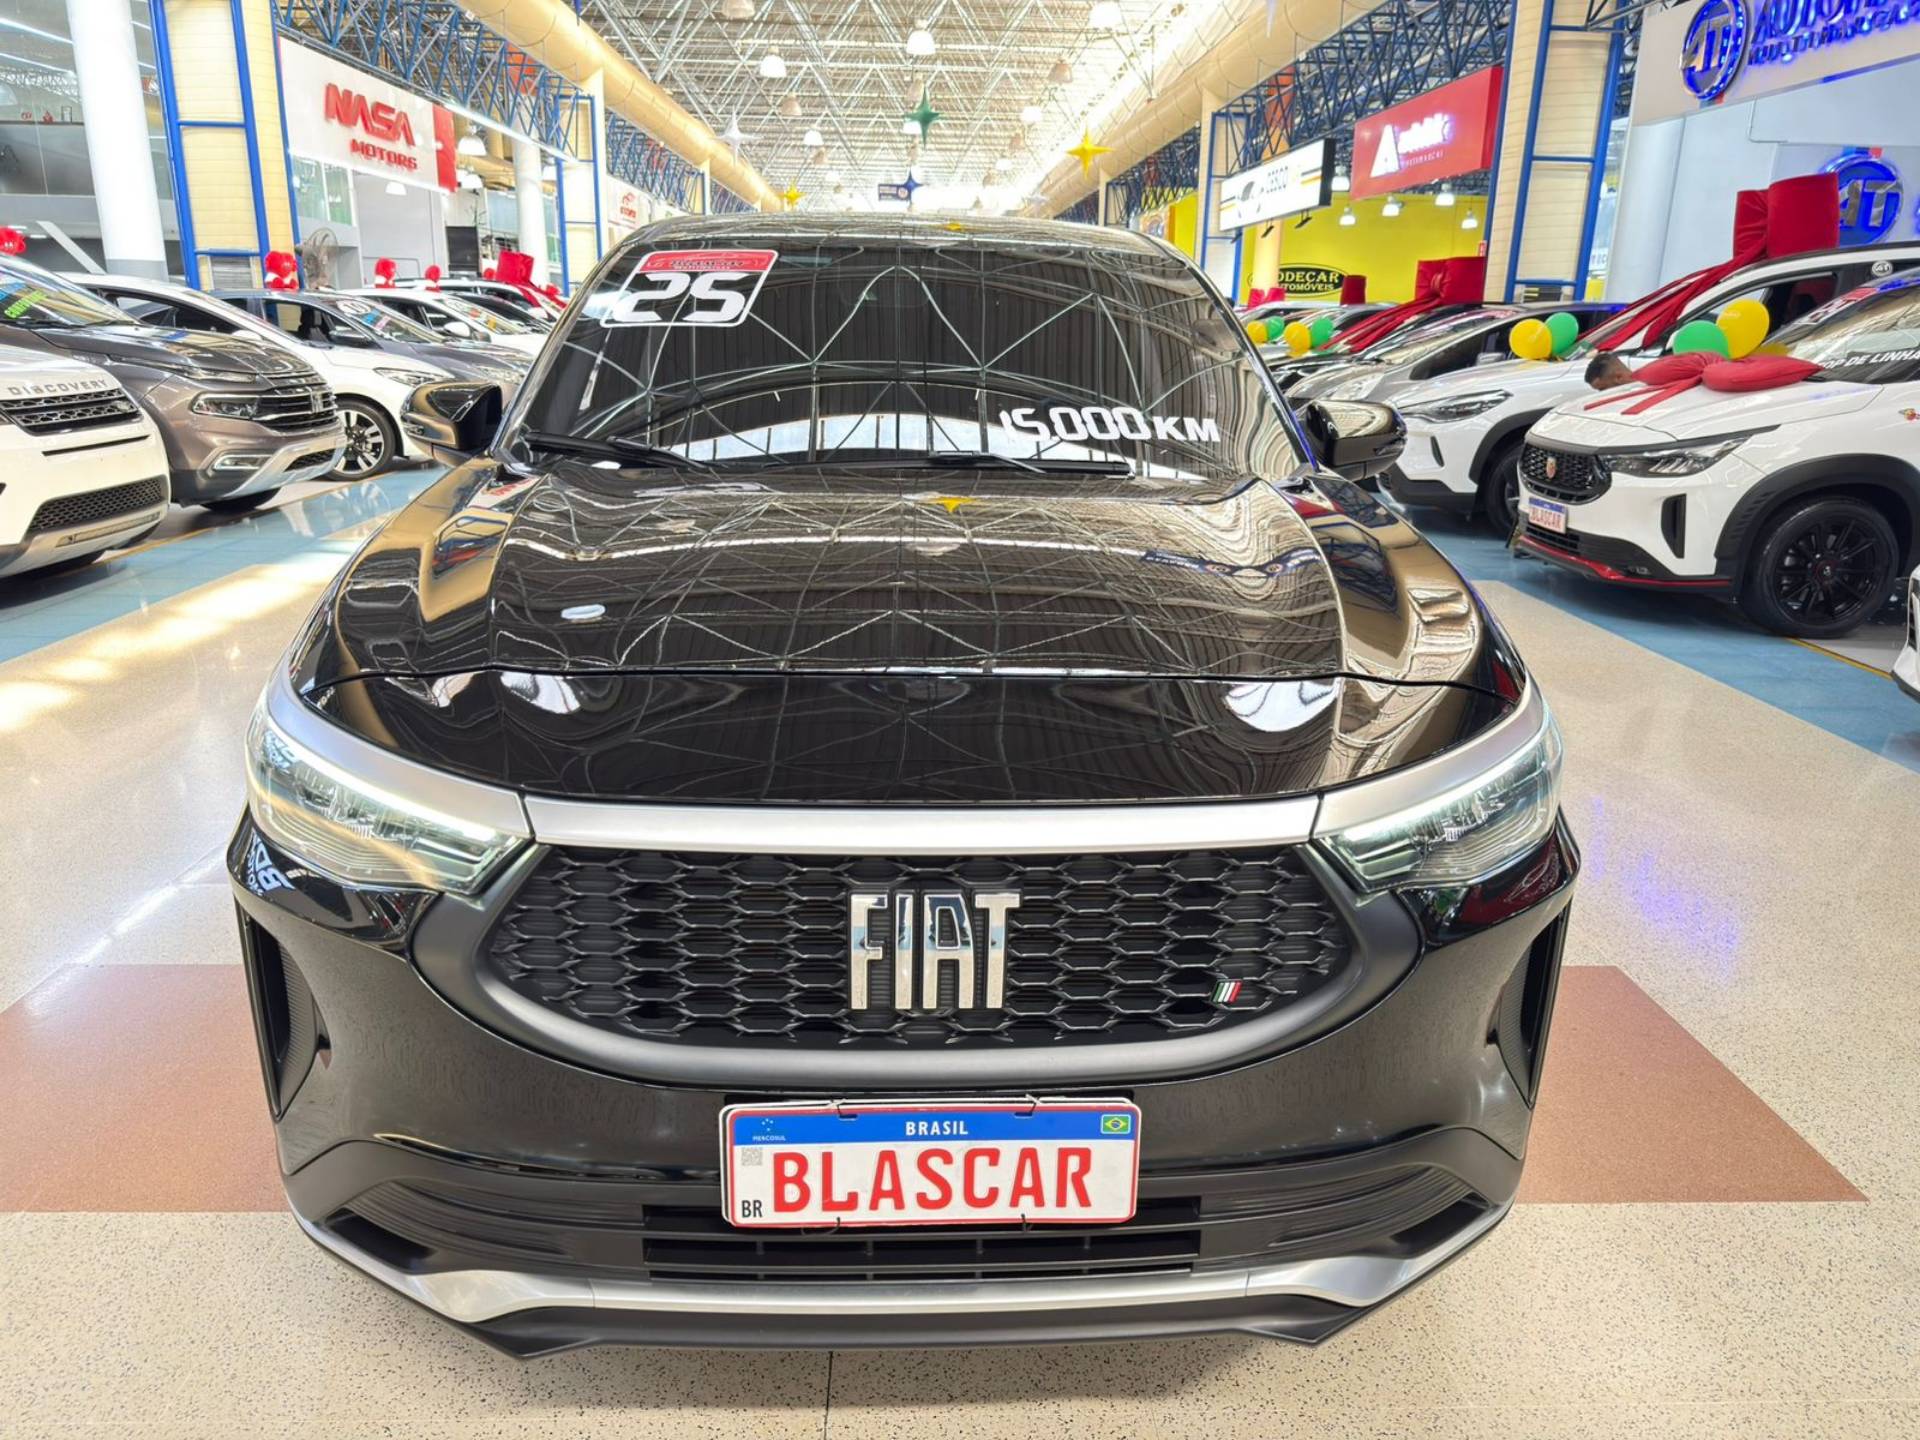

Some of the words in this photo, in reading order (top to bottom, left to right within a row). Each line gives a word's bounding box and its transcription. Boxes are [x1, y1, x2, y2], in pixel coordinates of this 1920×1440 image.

[325, 82, 416, 147] NASA
[350, 138, 418, 170] MOTORS
[612, 271, 751, 323] 25
[7, 379, 108, 396] DISCOVERY
[1152, 415, 1221, 442] KM
[851, 893, 1021, 1010] FIAT
[905, 1120, 968, 1136] BRASIL
[773, 1147, 1092, 1213] BLASCAR
[741, 1199, 763, 1218] BR
